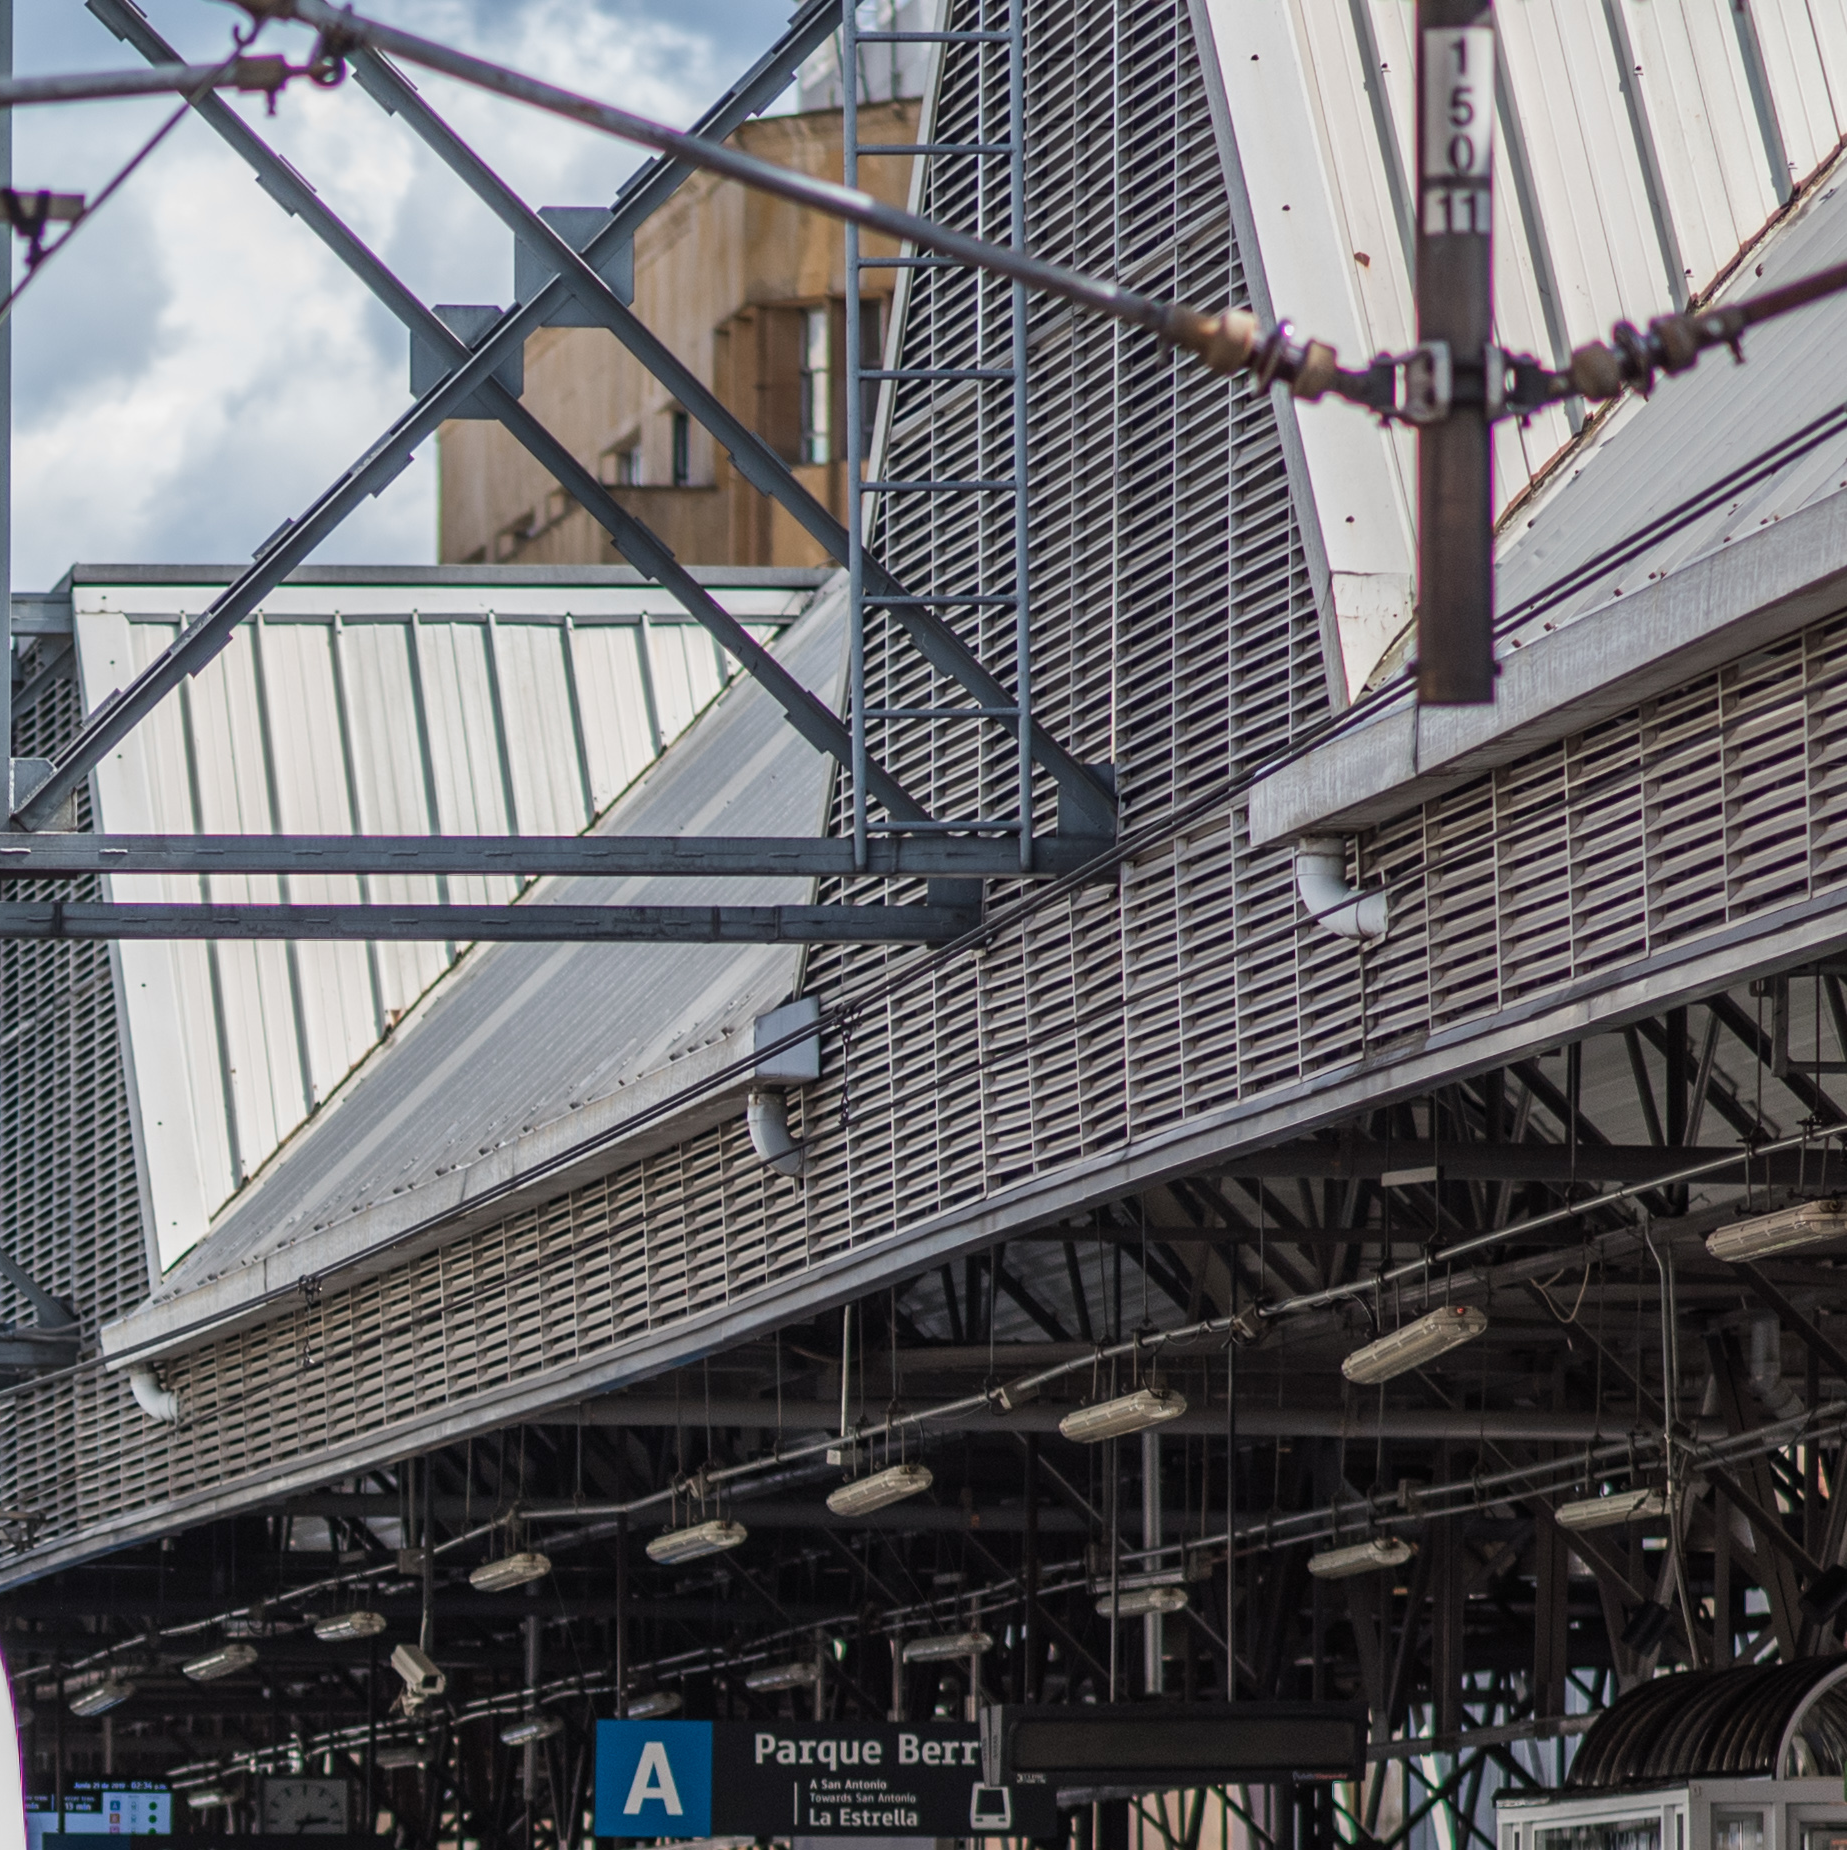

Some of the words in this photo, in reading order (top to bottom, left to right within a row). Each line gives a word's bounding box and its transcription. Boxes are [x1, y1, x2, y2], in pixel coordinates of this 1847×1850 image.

[1437, 193, 1476, 233] 11
[622, 1741, 684, 1815] A
[754, 1733, 882, 1771] Parque
[898, 1733, 981, 1765] Berr
[810, 1779, 819, 1790] A
[821, 1779, 841, 1790] San
[844, 1779, 888, 1790] Antonio
[810, 1793, 852, 1804] Towards
[855, 1793, 873, 1804] San
[875, 1793, 916, 1804] Antonio
[809, 1807, 832, 1826] La
[839, 1807, 918, 1827] Estrella
